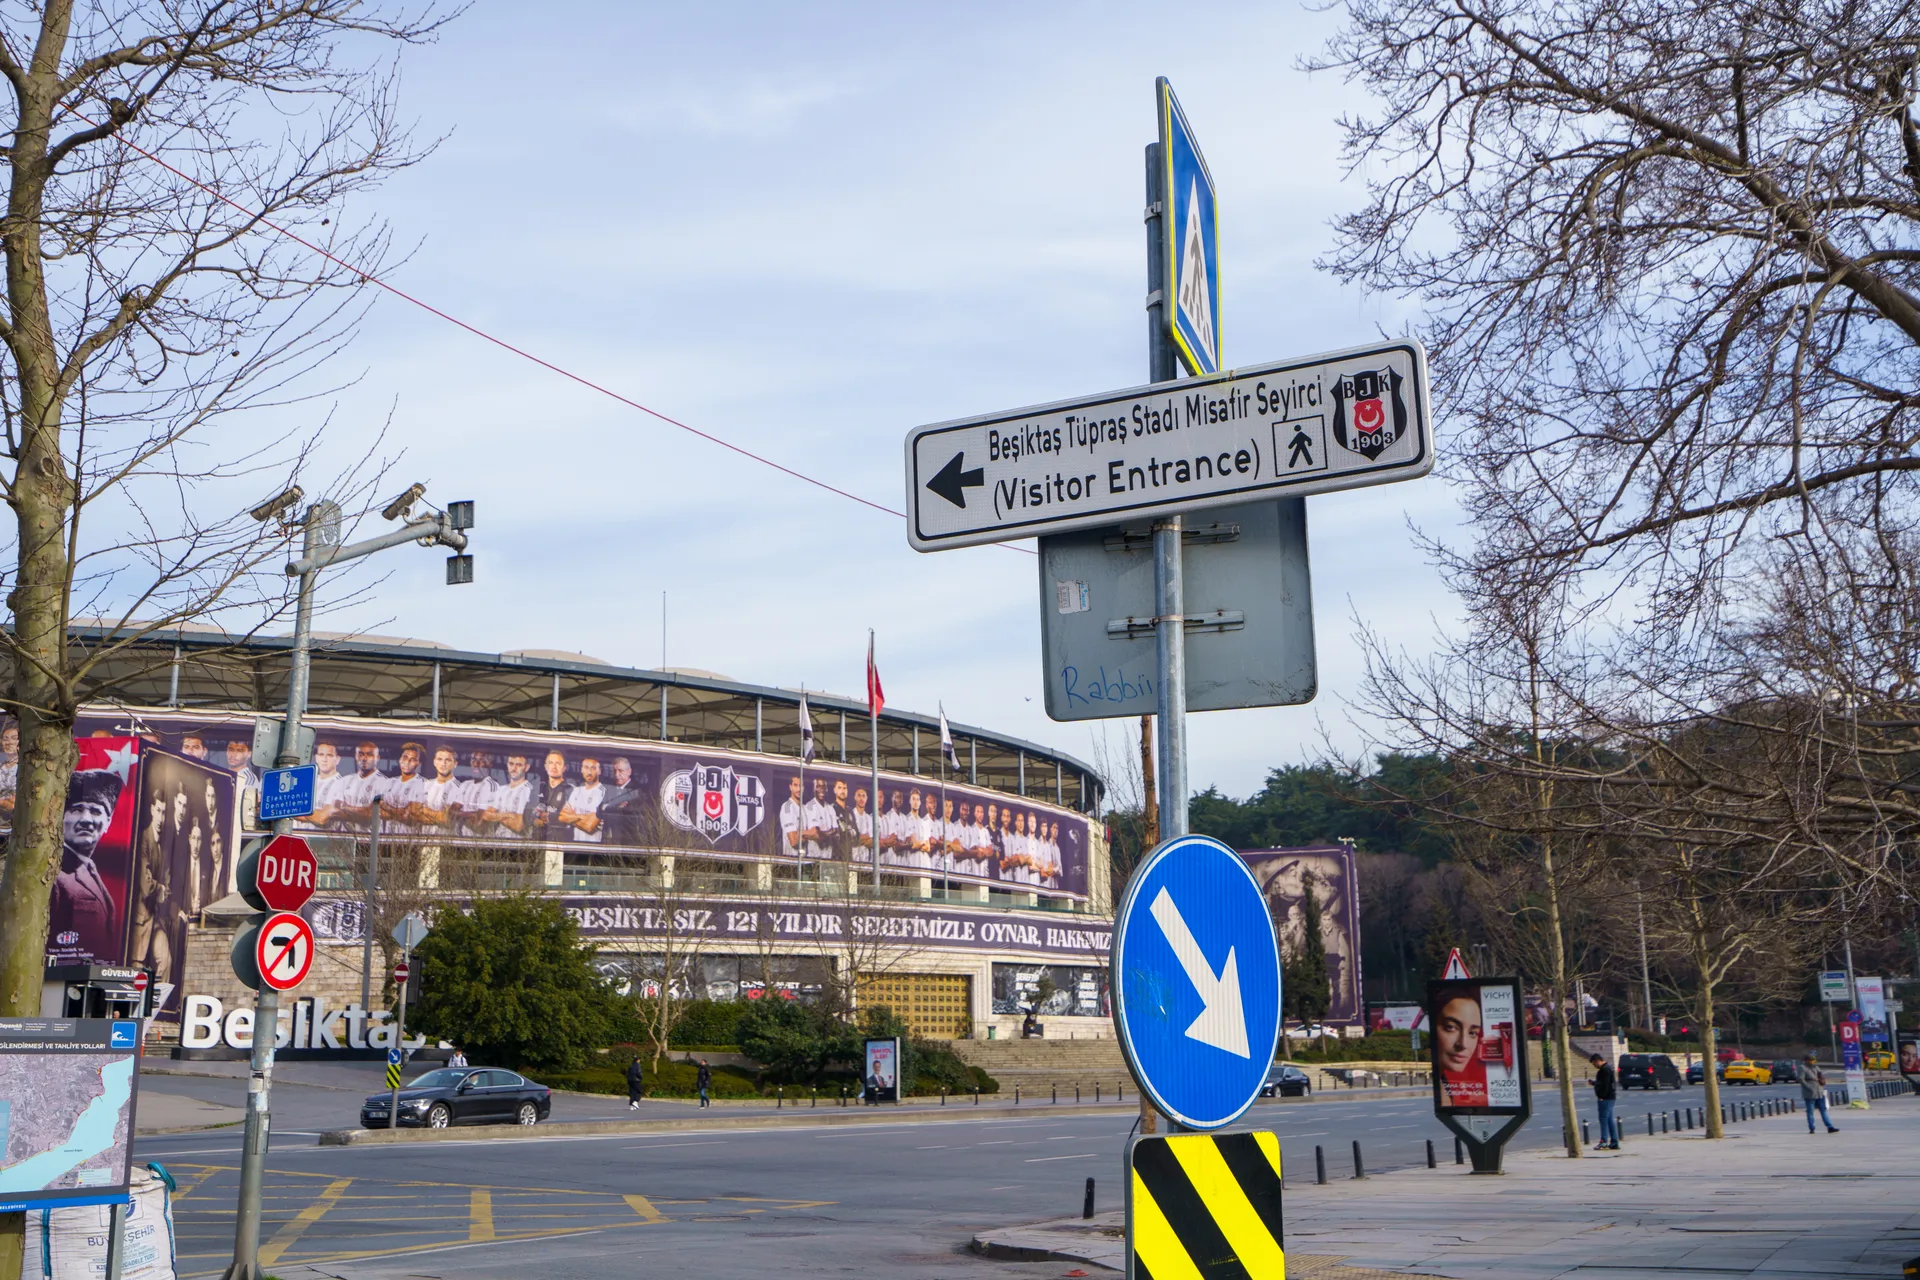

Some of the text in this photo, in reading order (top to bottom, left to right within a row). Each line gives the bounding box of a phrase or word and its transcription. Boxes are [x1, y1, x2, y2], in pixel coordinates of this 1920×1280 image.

[1343, 373, 1391, 399] BJK
[989, 374, 1323, 462] Beşiktaş Tüpraş Stadı Misafir Seyirci
[1350, 431, 1395, 450] 1903
[993, 438, 1260, 520] (Visitor Entrance)
[698, 772, 730, 789] BJK
[265, 800, 309, 810] Denetleme
[266, 792, 309, 803] Elektronik
[270, 808, 302, 816] Sistemi
[699, 820, 729, 832] 1903
[262, 855, 312, 889] DUR
[727, 911, 758, 932] 121
[768, 911, 843, 935] YILDIR
[981, 922, 1042, 948] OYNAR,
[1483, 991, 1511, 999] VICHY
